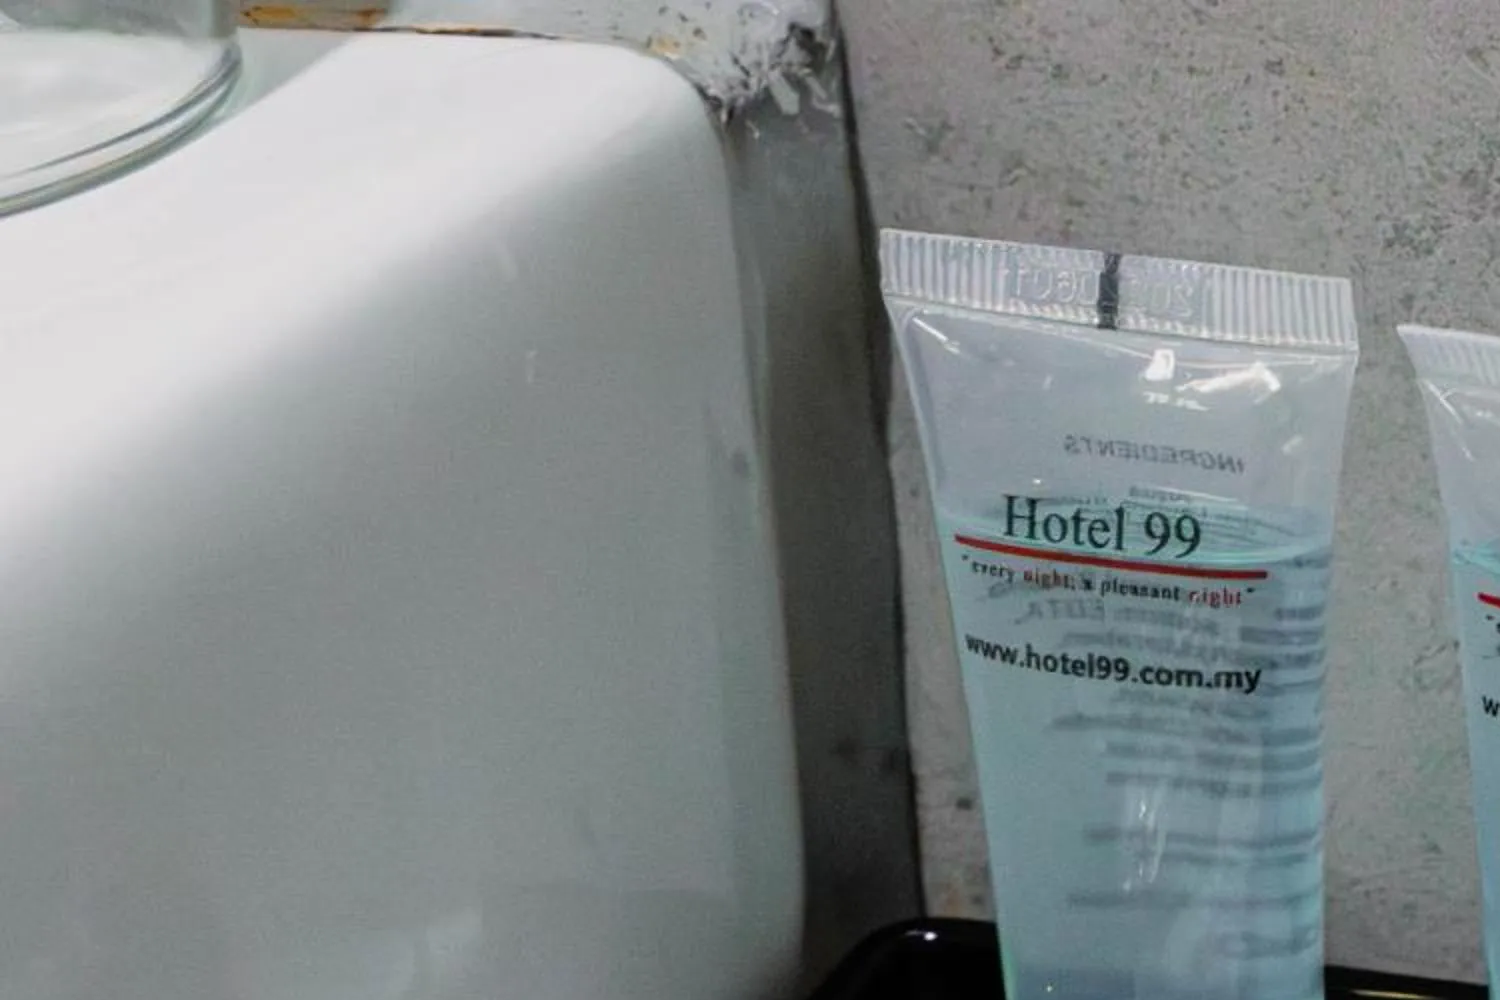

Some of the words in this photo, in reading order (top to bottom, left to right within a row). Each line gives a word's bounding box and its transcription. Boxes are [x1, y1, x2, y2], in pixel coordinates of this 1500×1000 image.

[1002, 494, 1128, 551] Hotel
[1143, 511, 1201, 559] 99
[1100, 577, 1181, 600] pleasant
[964, 633, 1262, 694] www.hotel99.com.my
